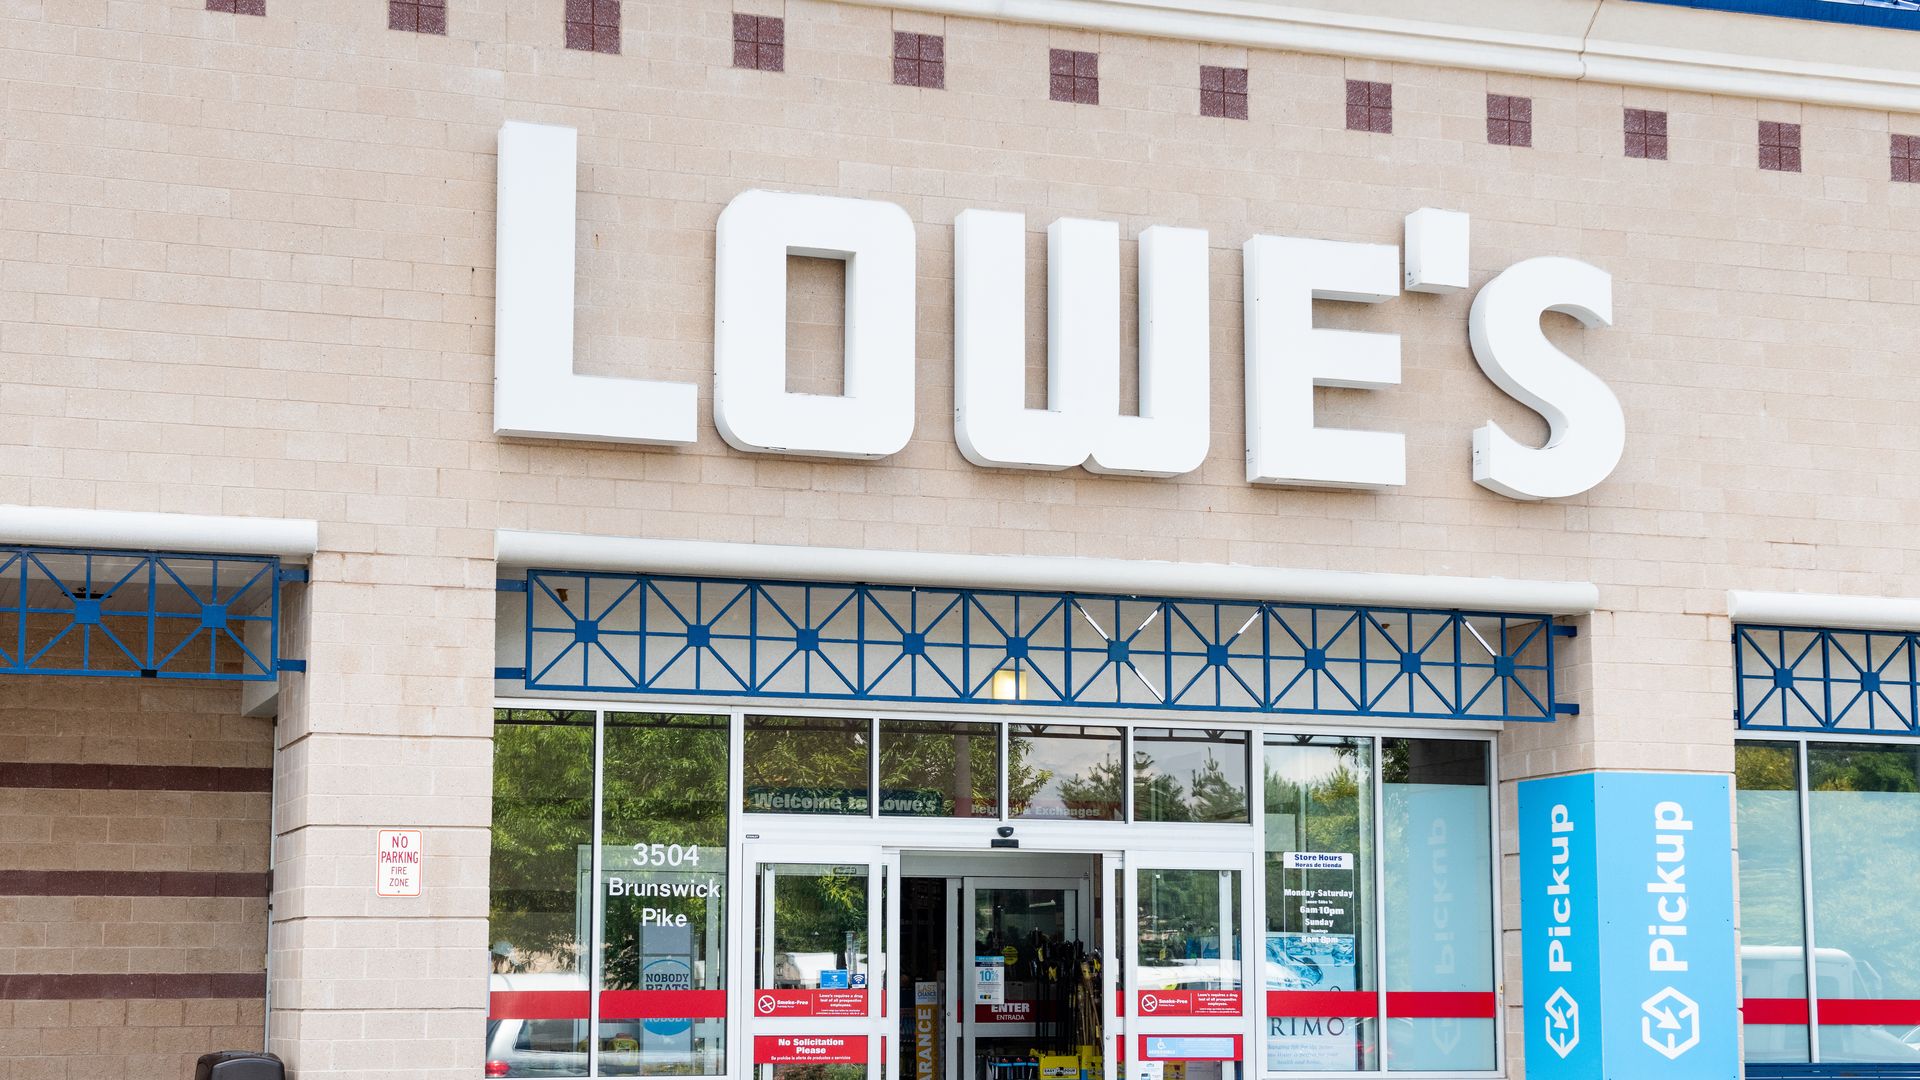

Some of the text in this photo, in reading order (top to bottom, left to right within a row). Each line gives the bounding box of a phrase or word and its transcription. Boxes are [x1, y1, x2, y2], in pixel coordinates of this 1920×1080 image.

[494, 121, 1626, 501] LOWE'S
[754, 793, 937, 812] Welcome to owe's
[1035, 806, 1101, 817] Exchanges
[392, 836, 409, 848] NO
[381, 851, 419, 864] PARKING
[632, 843, 700, 867] 3504
[391, 866, 407, 875] FIRE
[389, 878, 409, 887] ZONE
[609, 877, 721, 898] Brunswick
[1547, 804, 1574, 972] Pickup
[1647, 801, 1693, 972] Pickup
[642, 908, 688, 927] Pike
[1305, 918, 1334, 927] Sunday
[645, 973, 689, 982] NOBODY
[991, 1003, 1030, 1013] ENTER
[778, 1038, 844, 1046] No Solicitation
